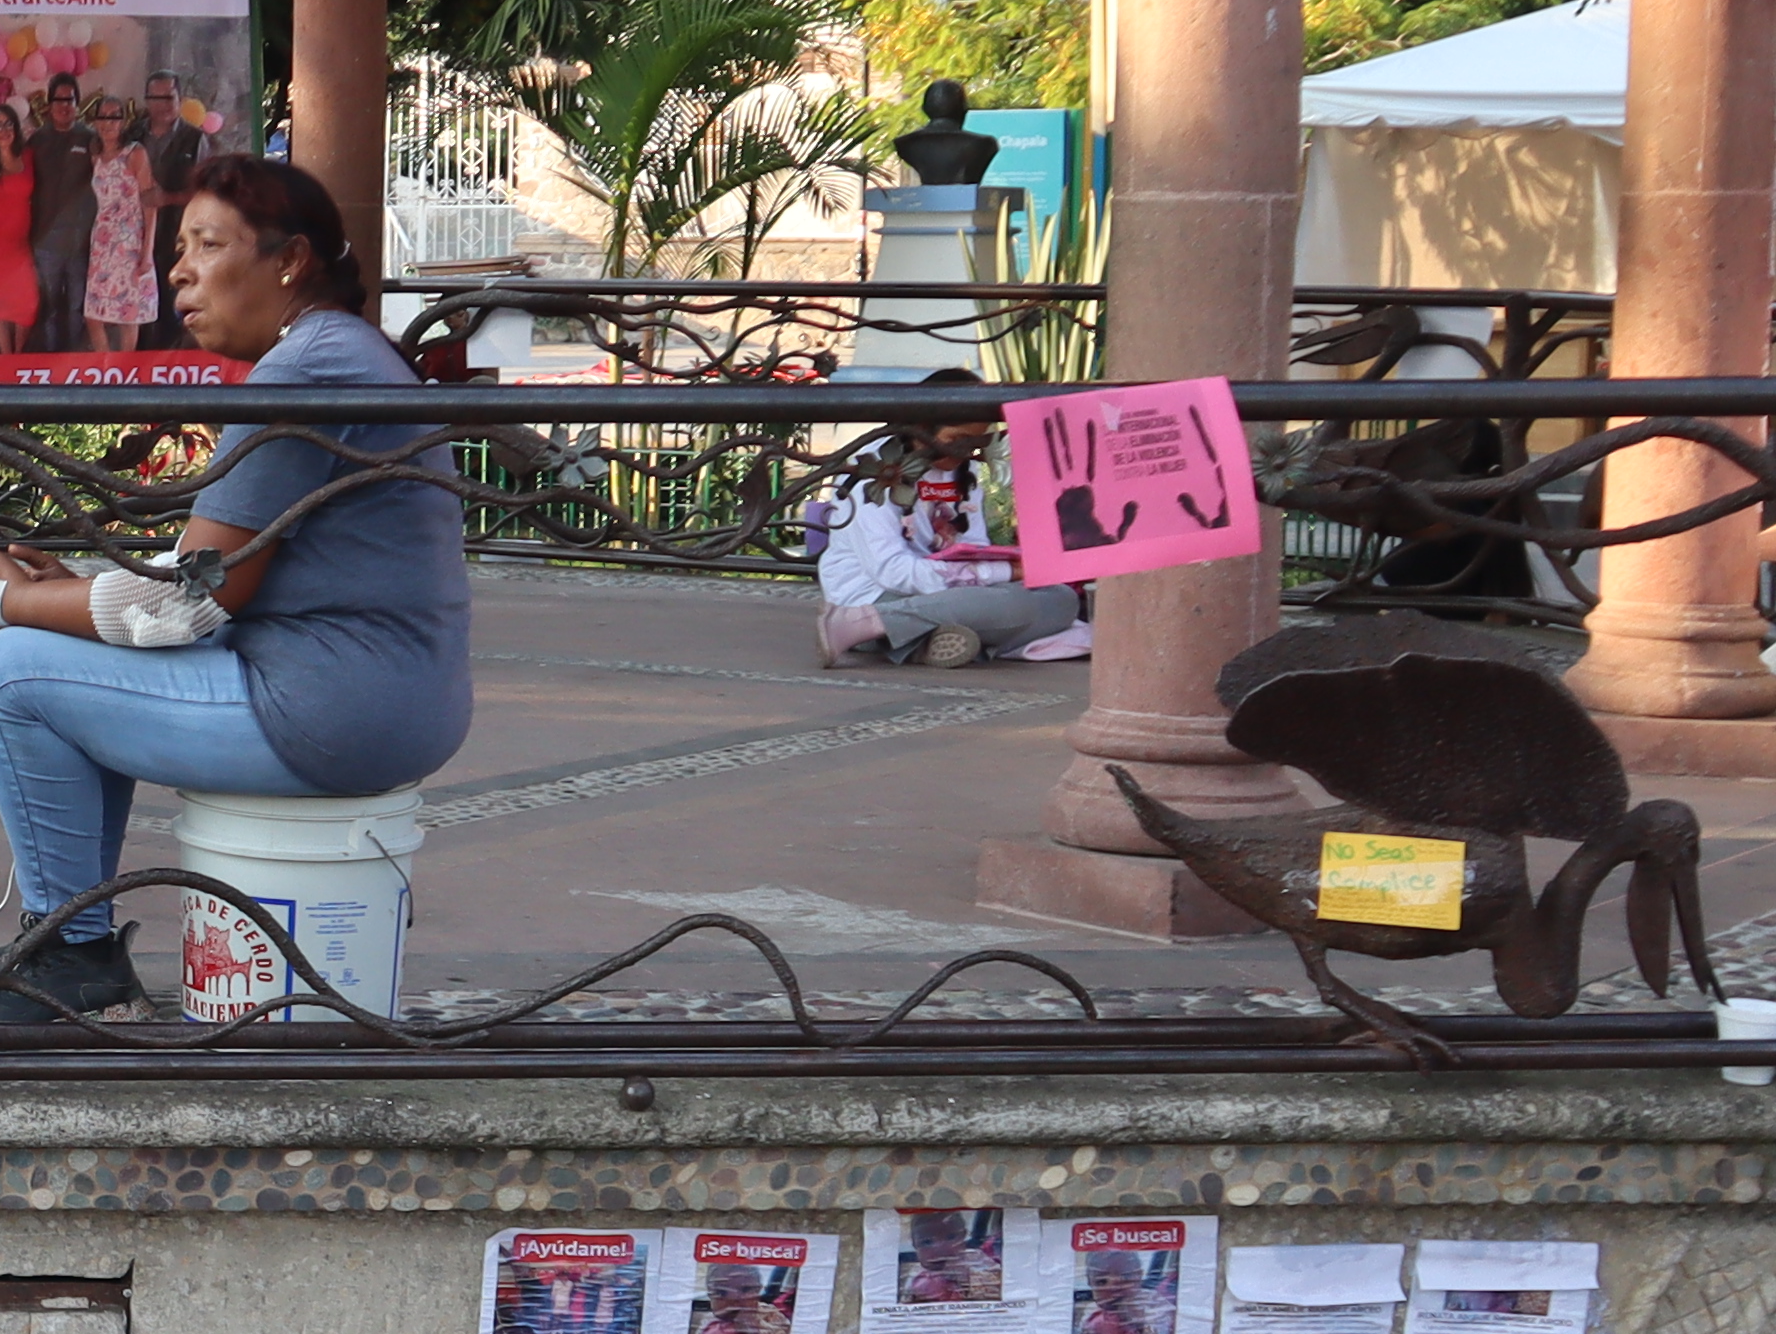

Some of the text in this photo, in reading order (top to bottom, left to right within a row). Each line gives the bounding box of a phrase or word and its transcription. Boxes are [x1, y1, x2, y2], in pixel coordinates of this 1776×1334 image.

[999, 134, 1048, 150] Chapala
[207, 899, 230, 920] DE
[233, 918, 275, 983] CERDO
[1077, 1226, 1178, 1247] ¡Se busca!
[520, 1239, 627, 1259] ¡Ayúdame!
[700, 1241, 800, 1260] ¡Se busca!
